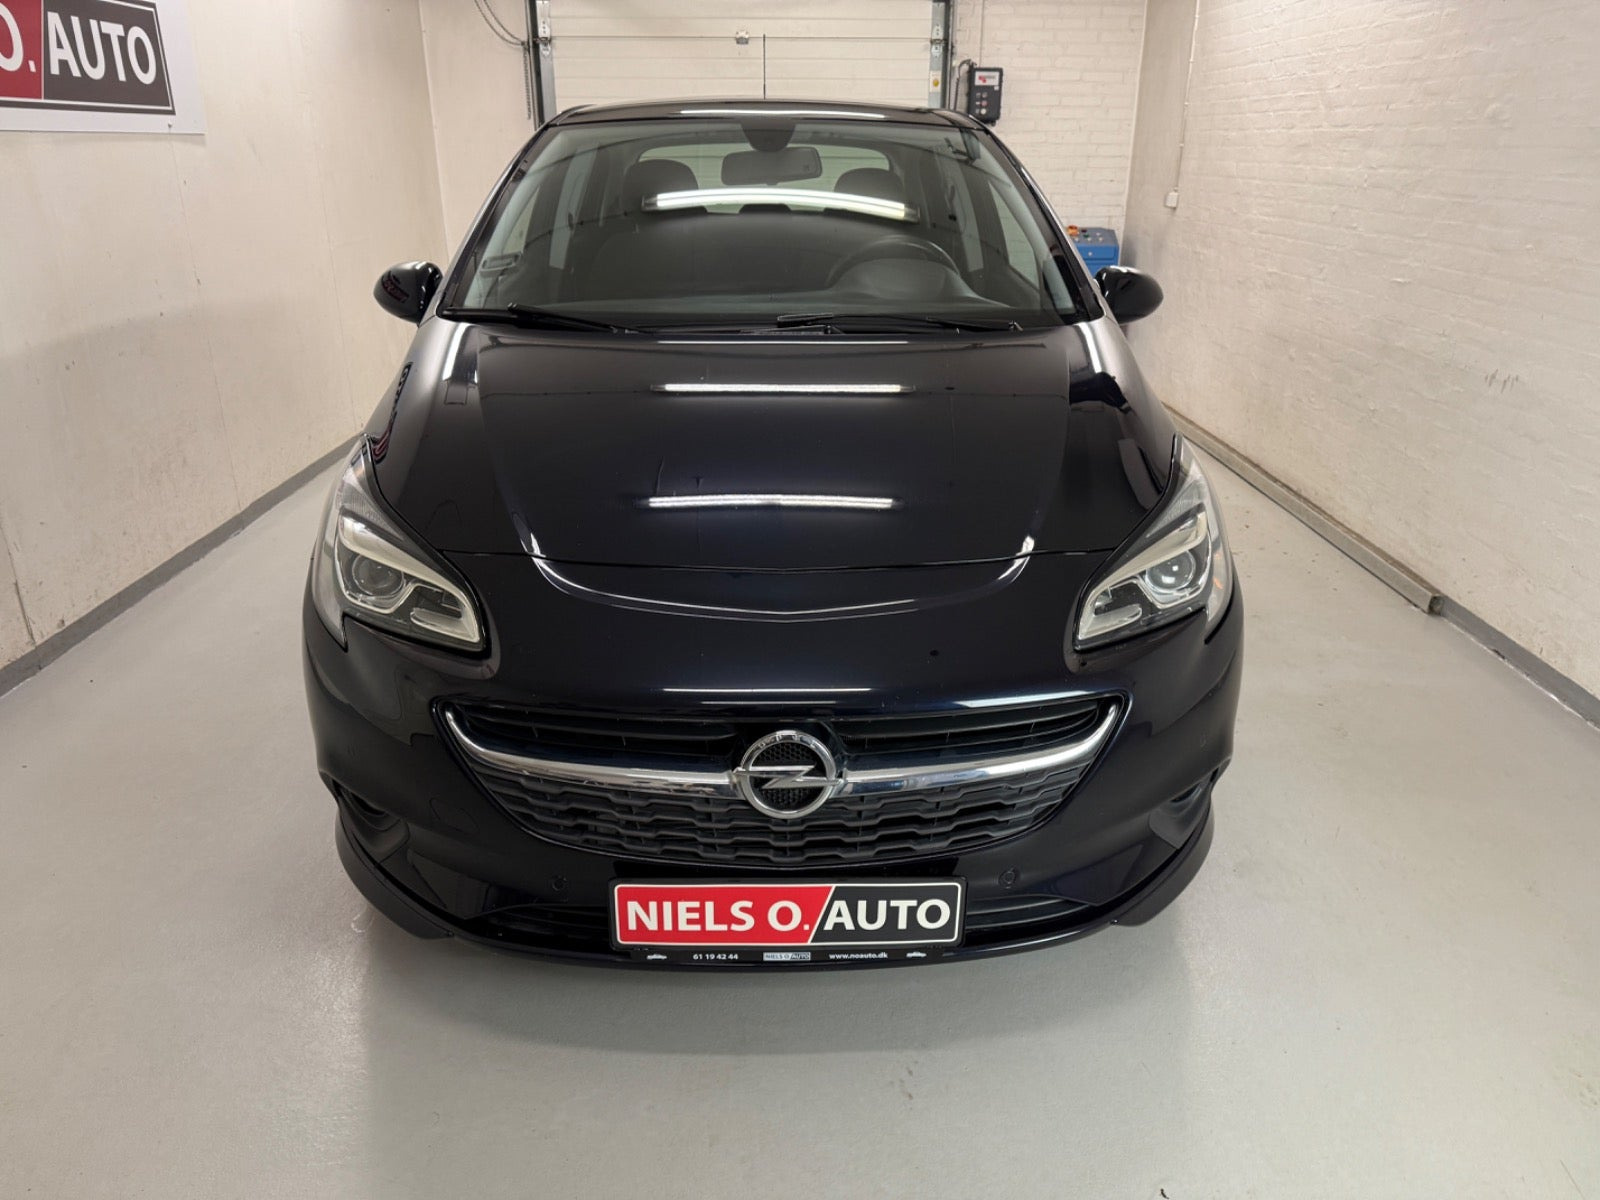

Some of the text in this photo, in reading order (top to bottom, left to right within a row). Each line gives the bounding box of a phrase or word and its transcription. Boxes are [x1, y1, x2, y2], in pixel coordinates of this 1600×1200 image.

[47, 11, 157, 85] AUTO
[627, 899, 951, 932] NIELS O. AUTO
[829, 951, 888, 960] www.noauto.dk
